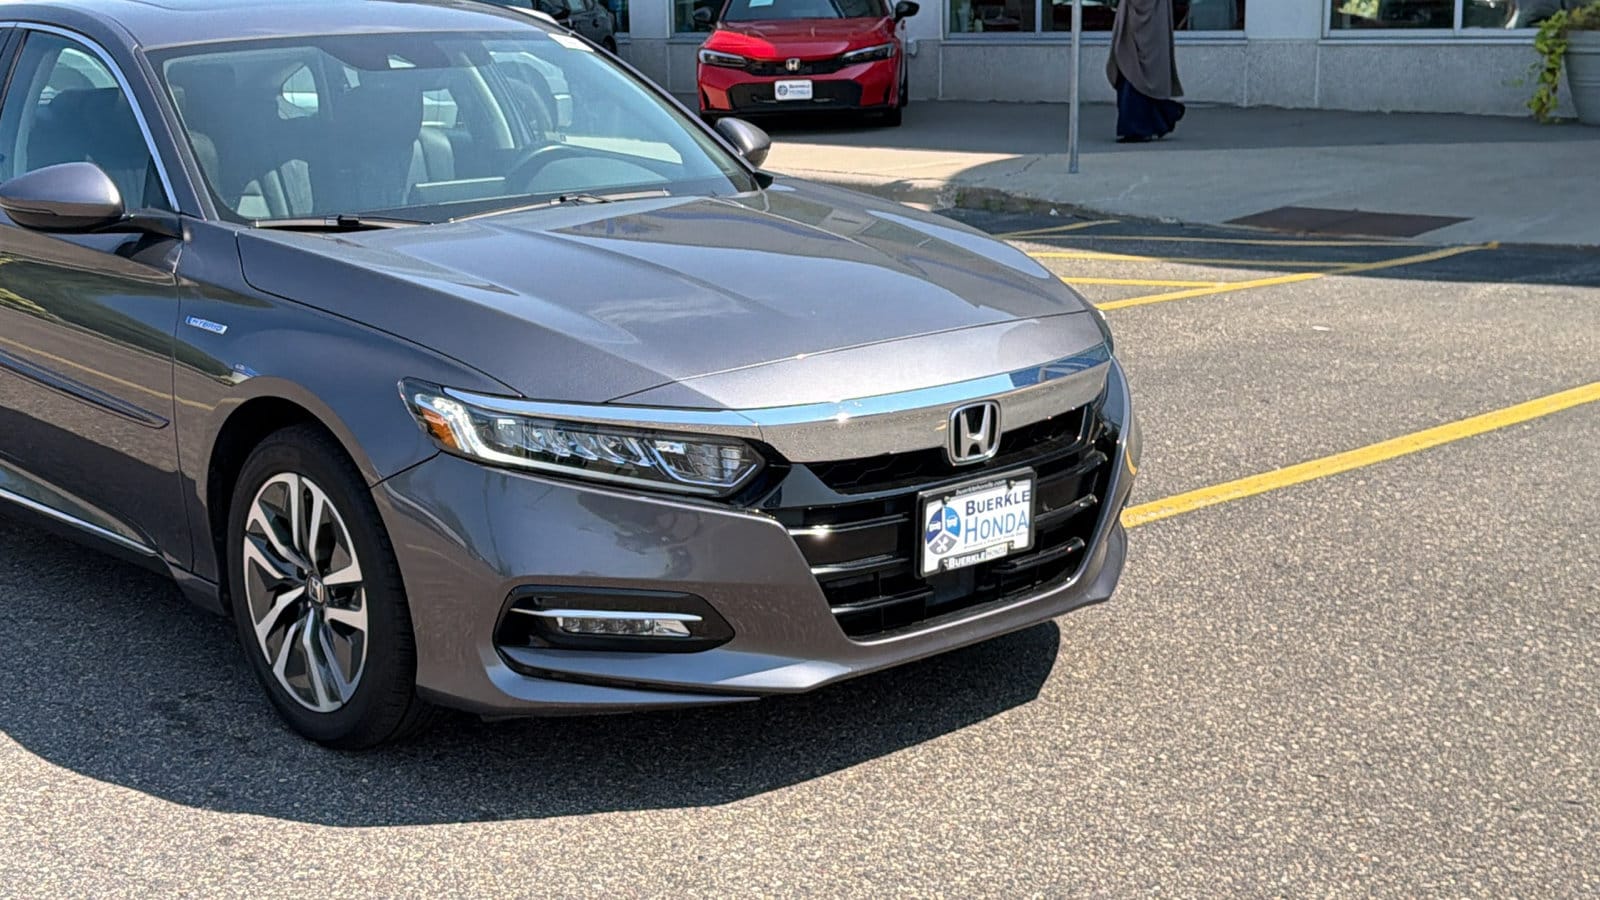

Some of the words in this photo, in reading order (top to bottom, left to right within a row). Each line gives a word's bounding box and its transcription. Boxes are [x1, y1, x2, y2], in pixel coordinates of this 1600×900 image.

[189, 316, 224, 333] HYBRID
[965, 489, 1031, 516] BUERKLE
[964, 509, 1029, 544] HONDA
